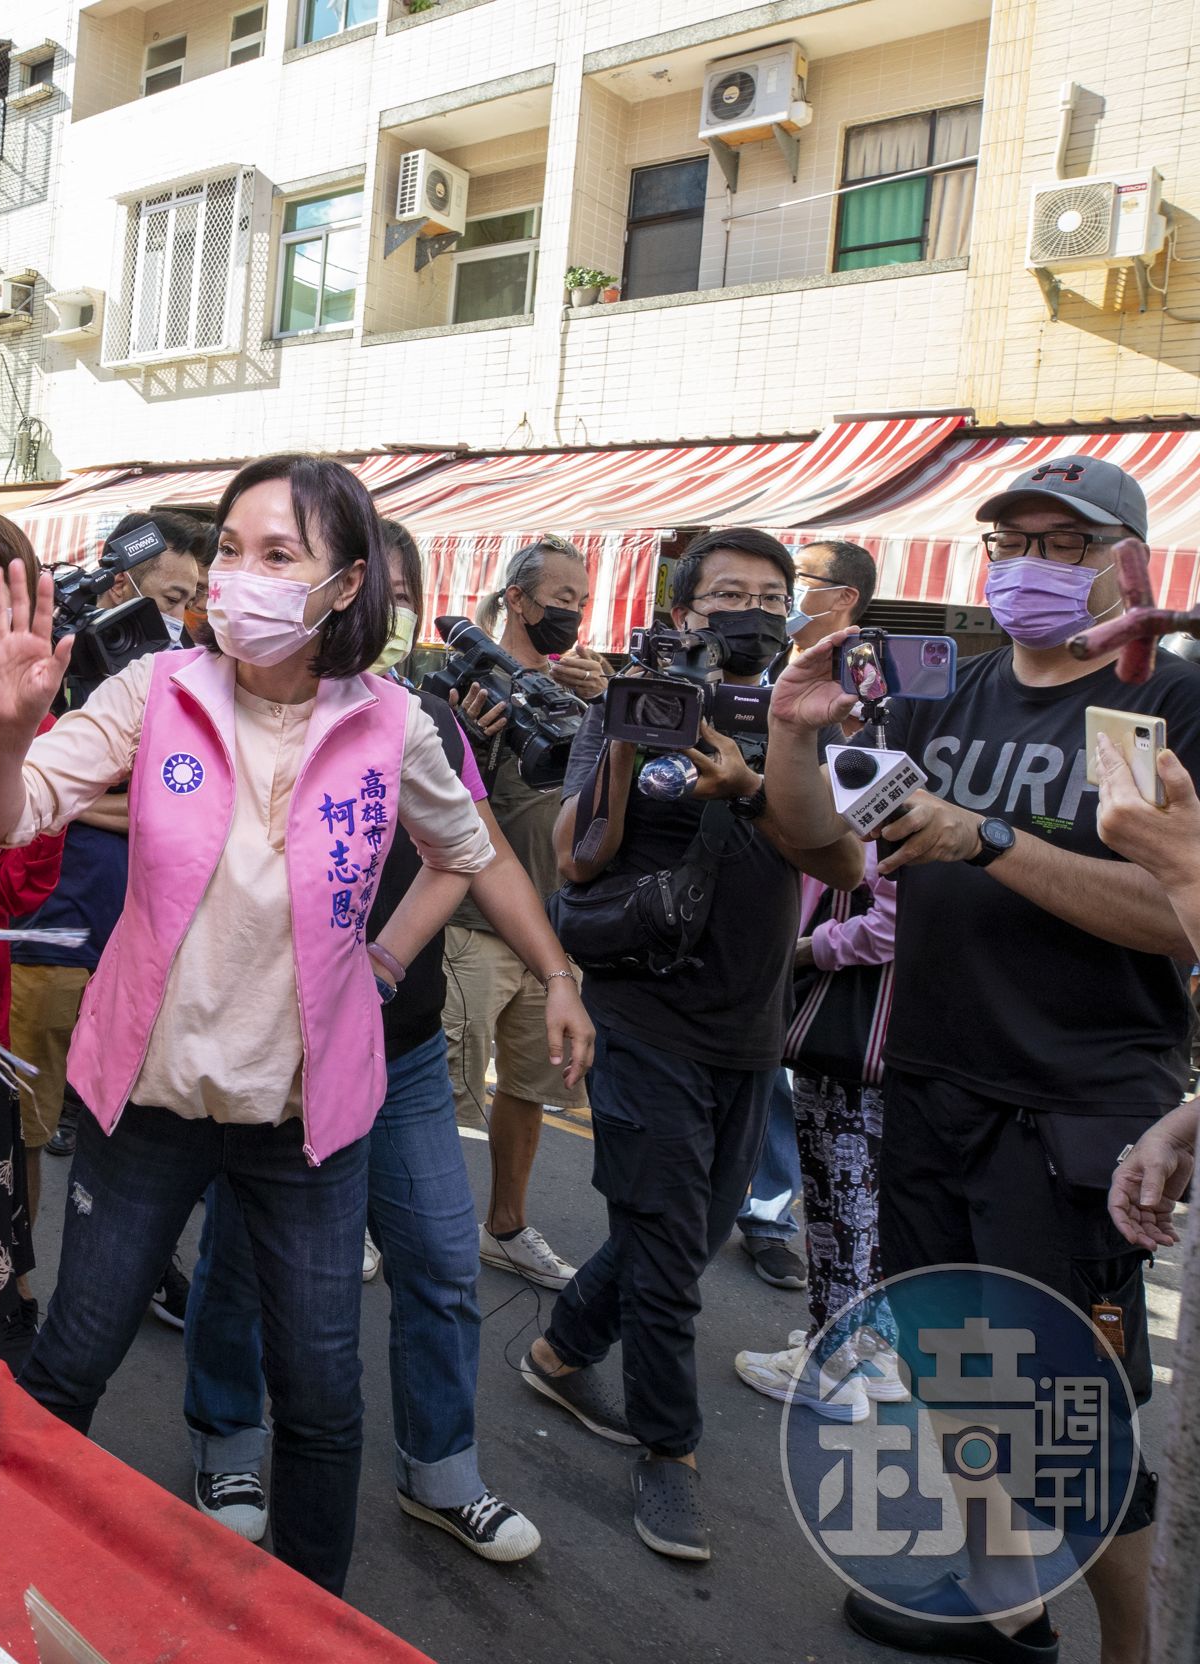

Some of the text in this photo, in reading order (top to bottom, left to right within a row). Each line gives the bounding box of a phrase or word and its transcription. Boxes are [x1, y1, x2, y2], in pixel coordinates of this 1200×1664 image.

[128, 537, 156, 554] mnews
[734, 695, 760, 703] Panasonic
[318, 793, 360, 928] 柯志恩
